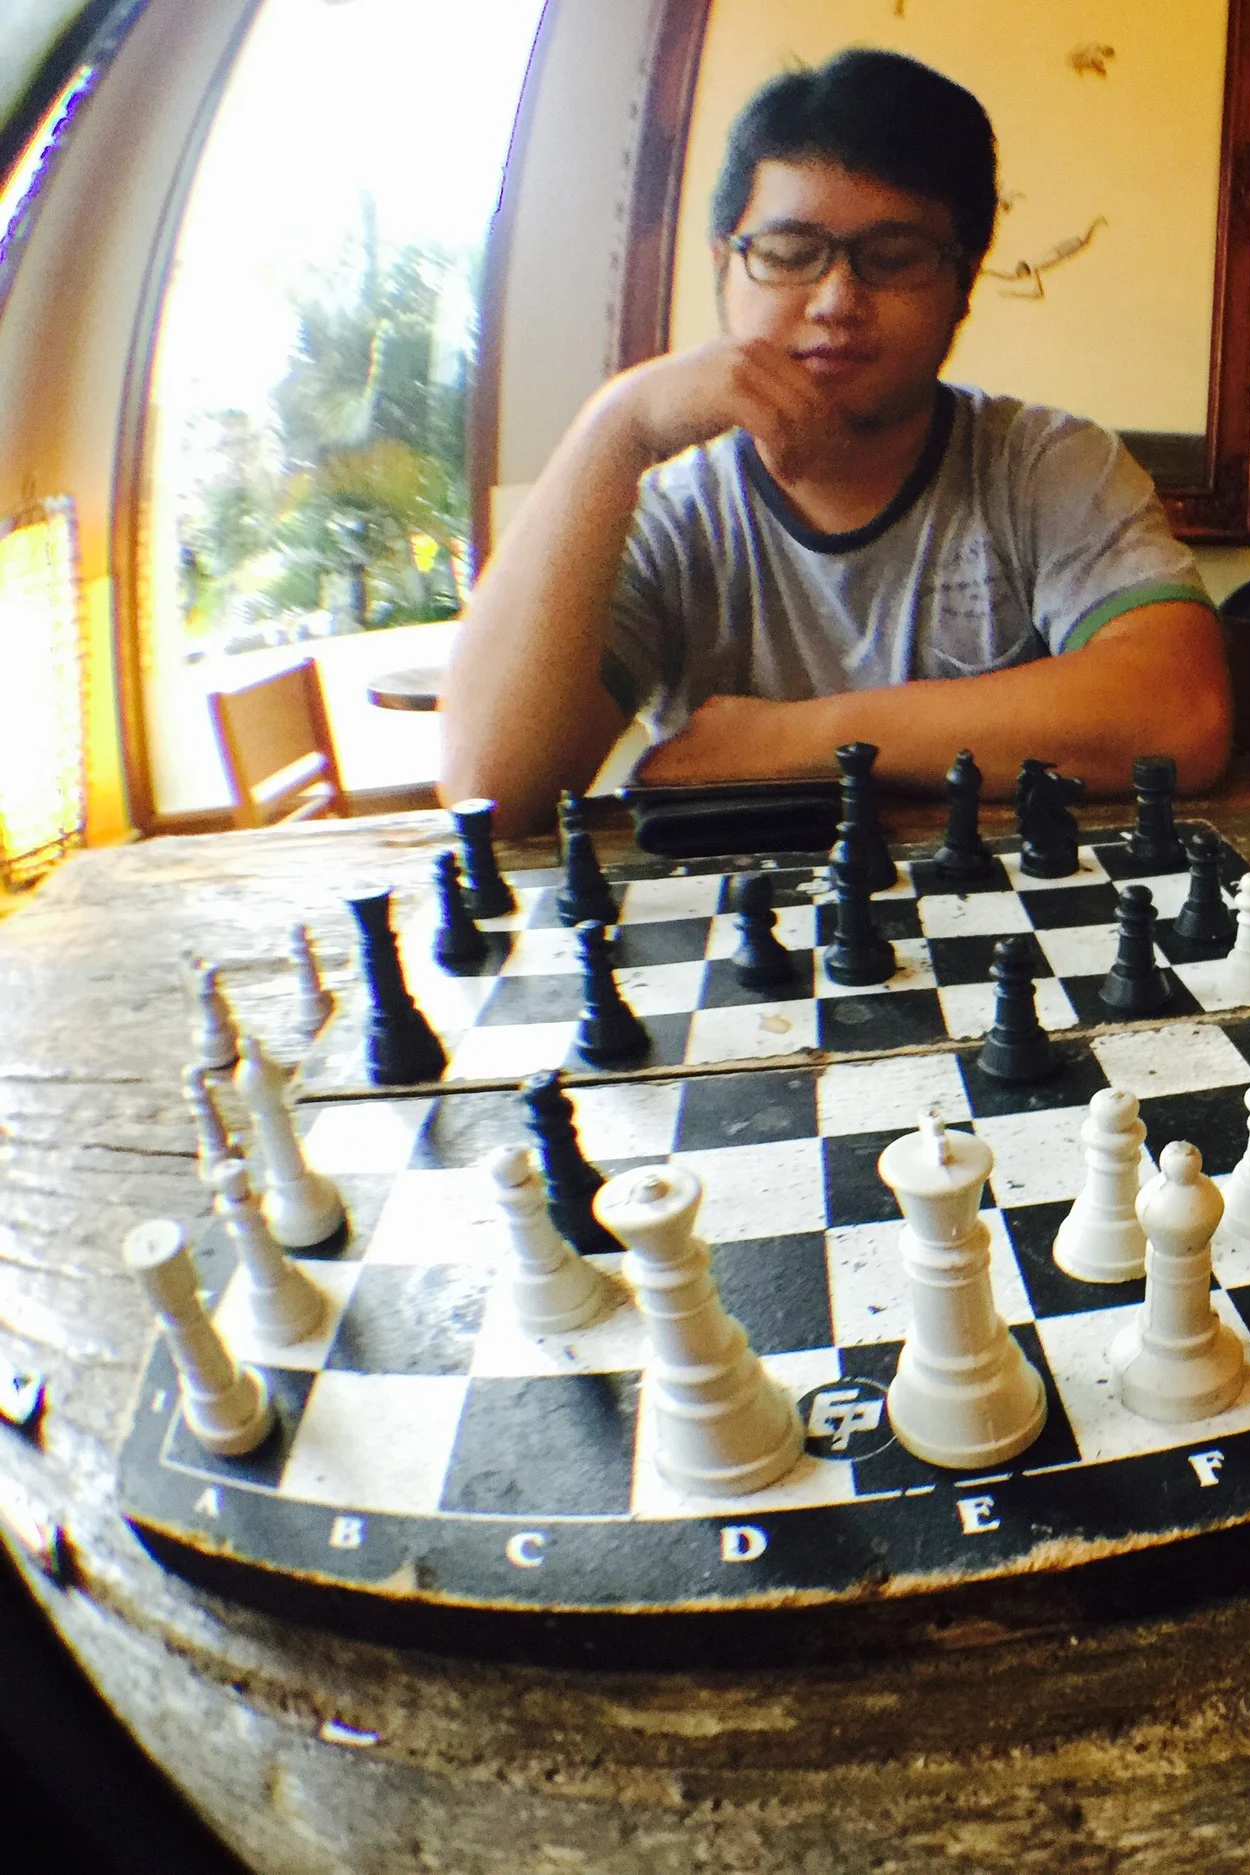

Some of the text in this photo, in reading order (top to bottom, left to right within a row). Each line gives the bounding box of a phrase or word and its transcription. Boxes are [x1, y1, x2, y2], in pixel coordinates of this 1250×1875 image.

[193, 1487, 223, 1518] A
[329, 1516, 367, 1550] B
[506, 1531, 546, 1568] C
[720, 1525, 768, 1562] D
[956, 1495, 1000, 1535] E
[1188, 1449, 1226, 1487] F
